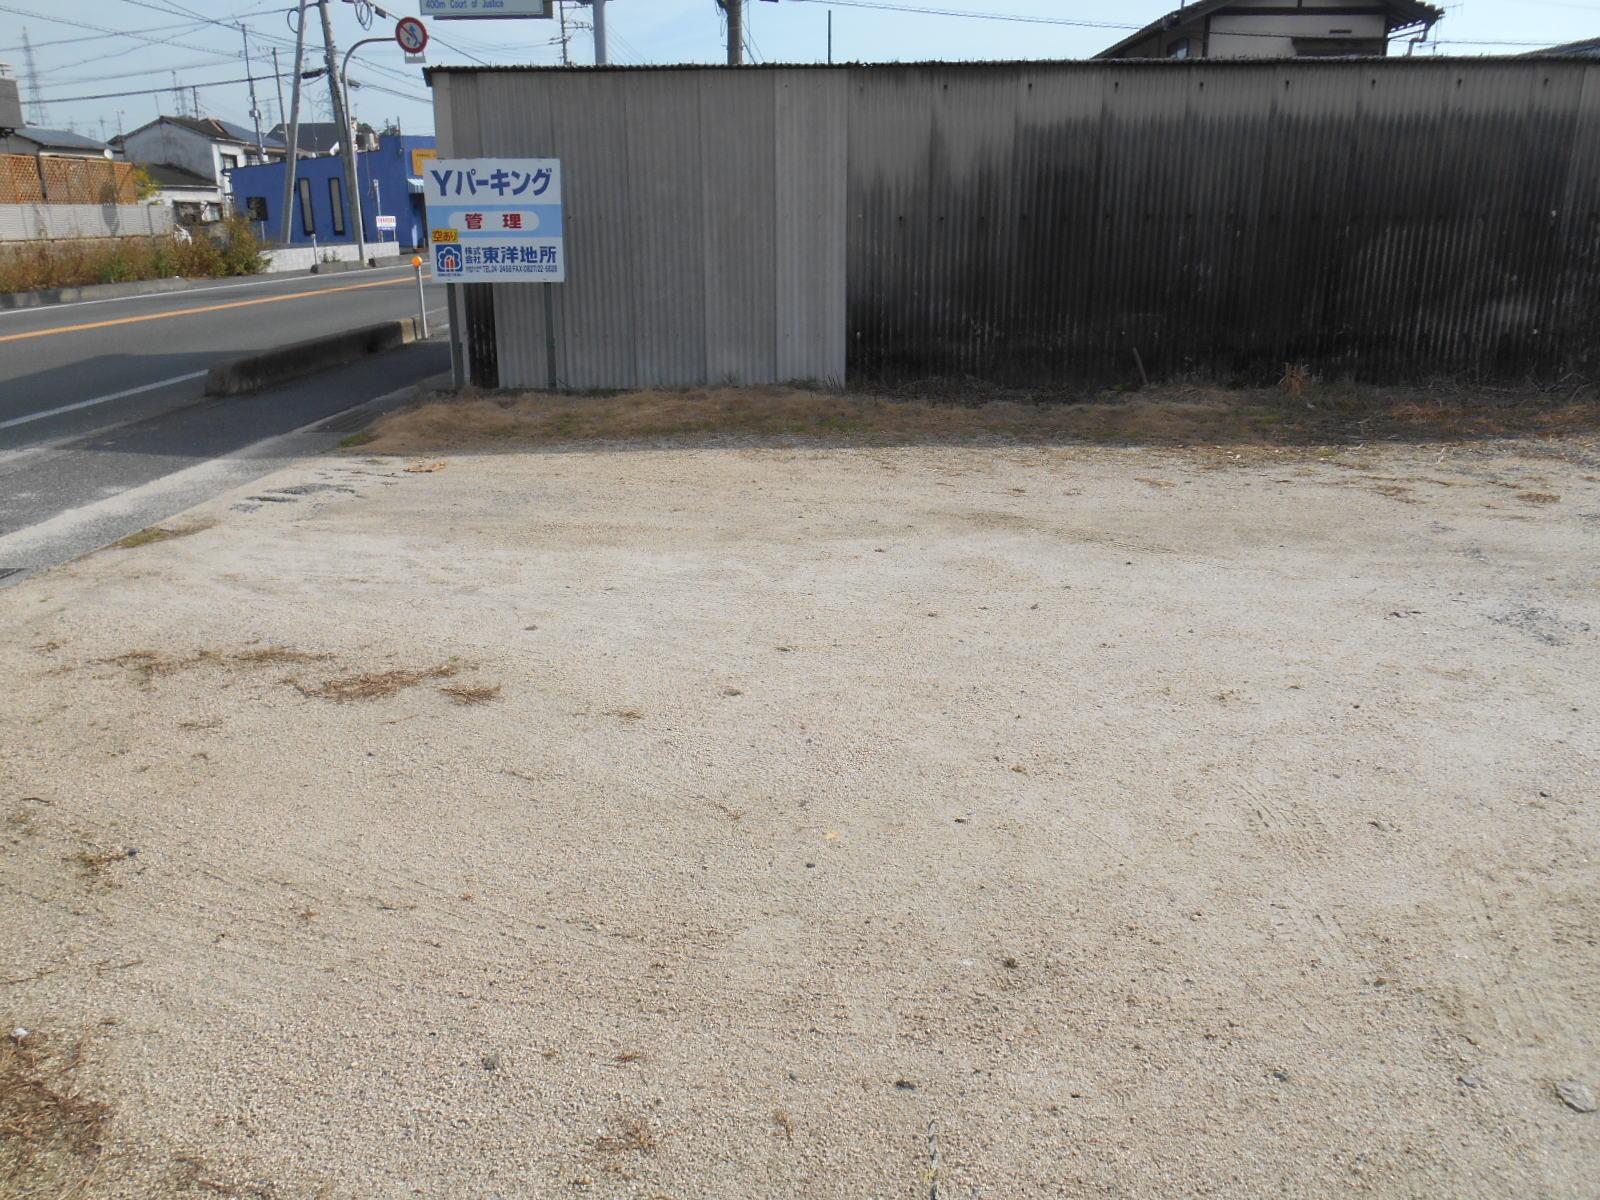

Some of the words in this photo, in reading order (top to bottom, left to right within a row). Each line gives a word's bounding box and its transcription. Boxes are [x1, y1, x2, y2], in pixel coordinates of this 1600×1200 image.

[426, 0, 445, 8] 400m
[450, 0, 468, 8] Court
[482, 0, 504, 8] Justice
[431, 168, 552, 196] Yパーキング
[465, 213, 522, 229] 管理
[482, 246, 557, 264] 東洋地所
